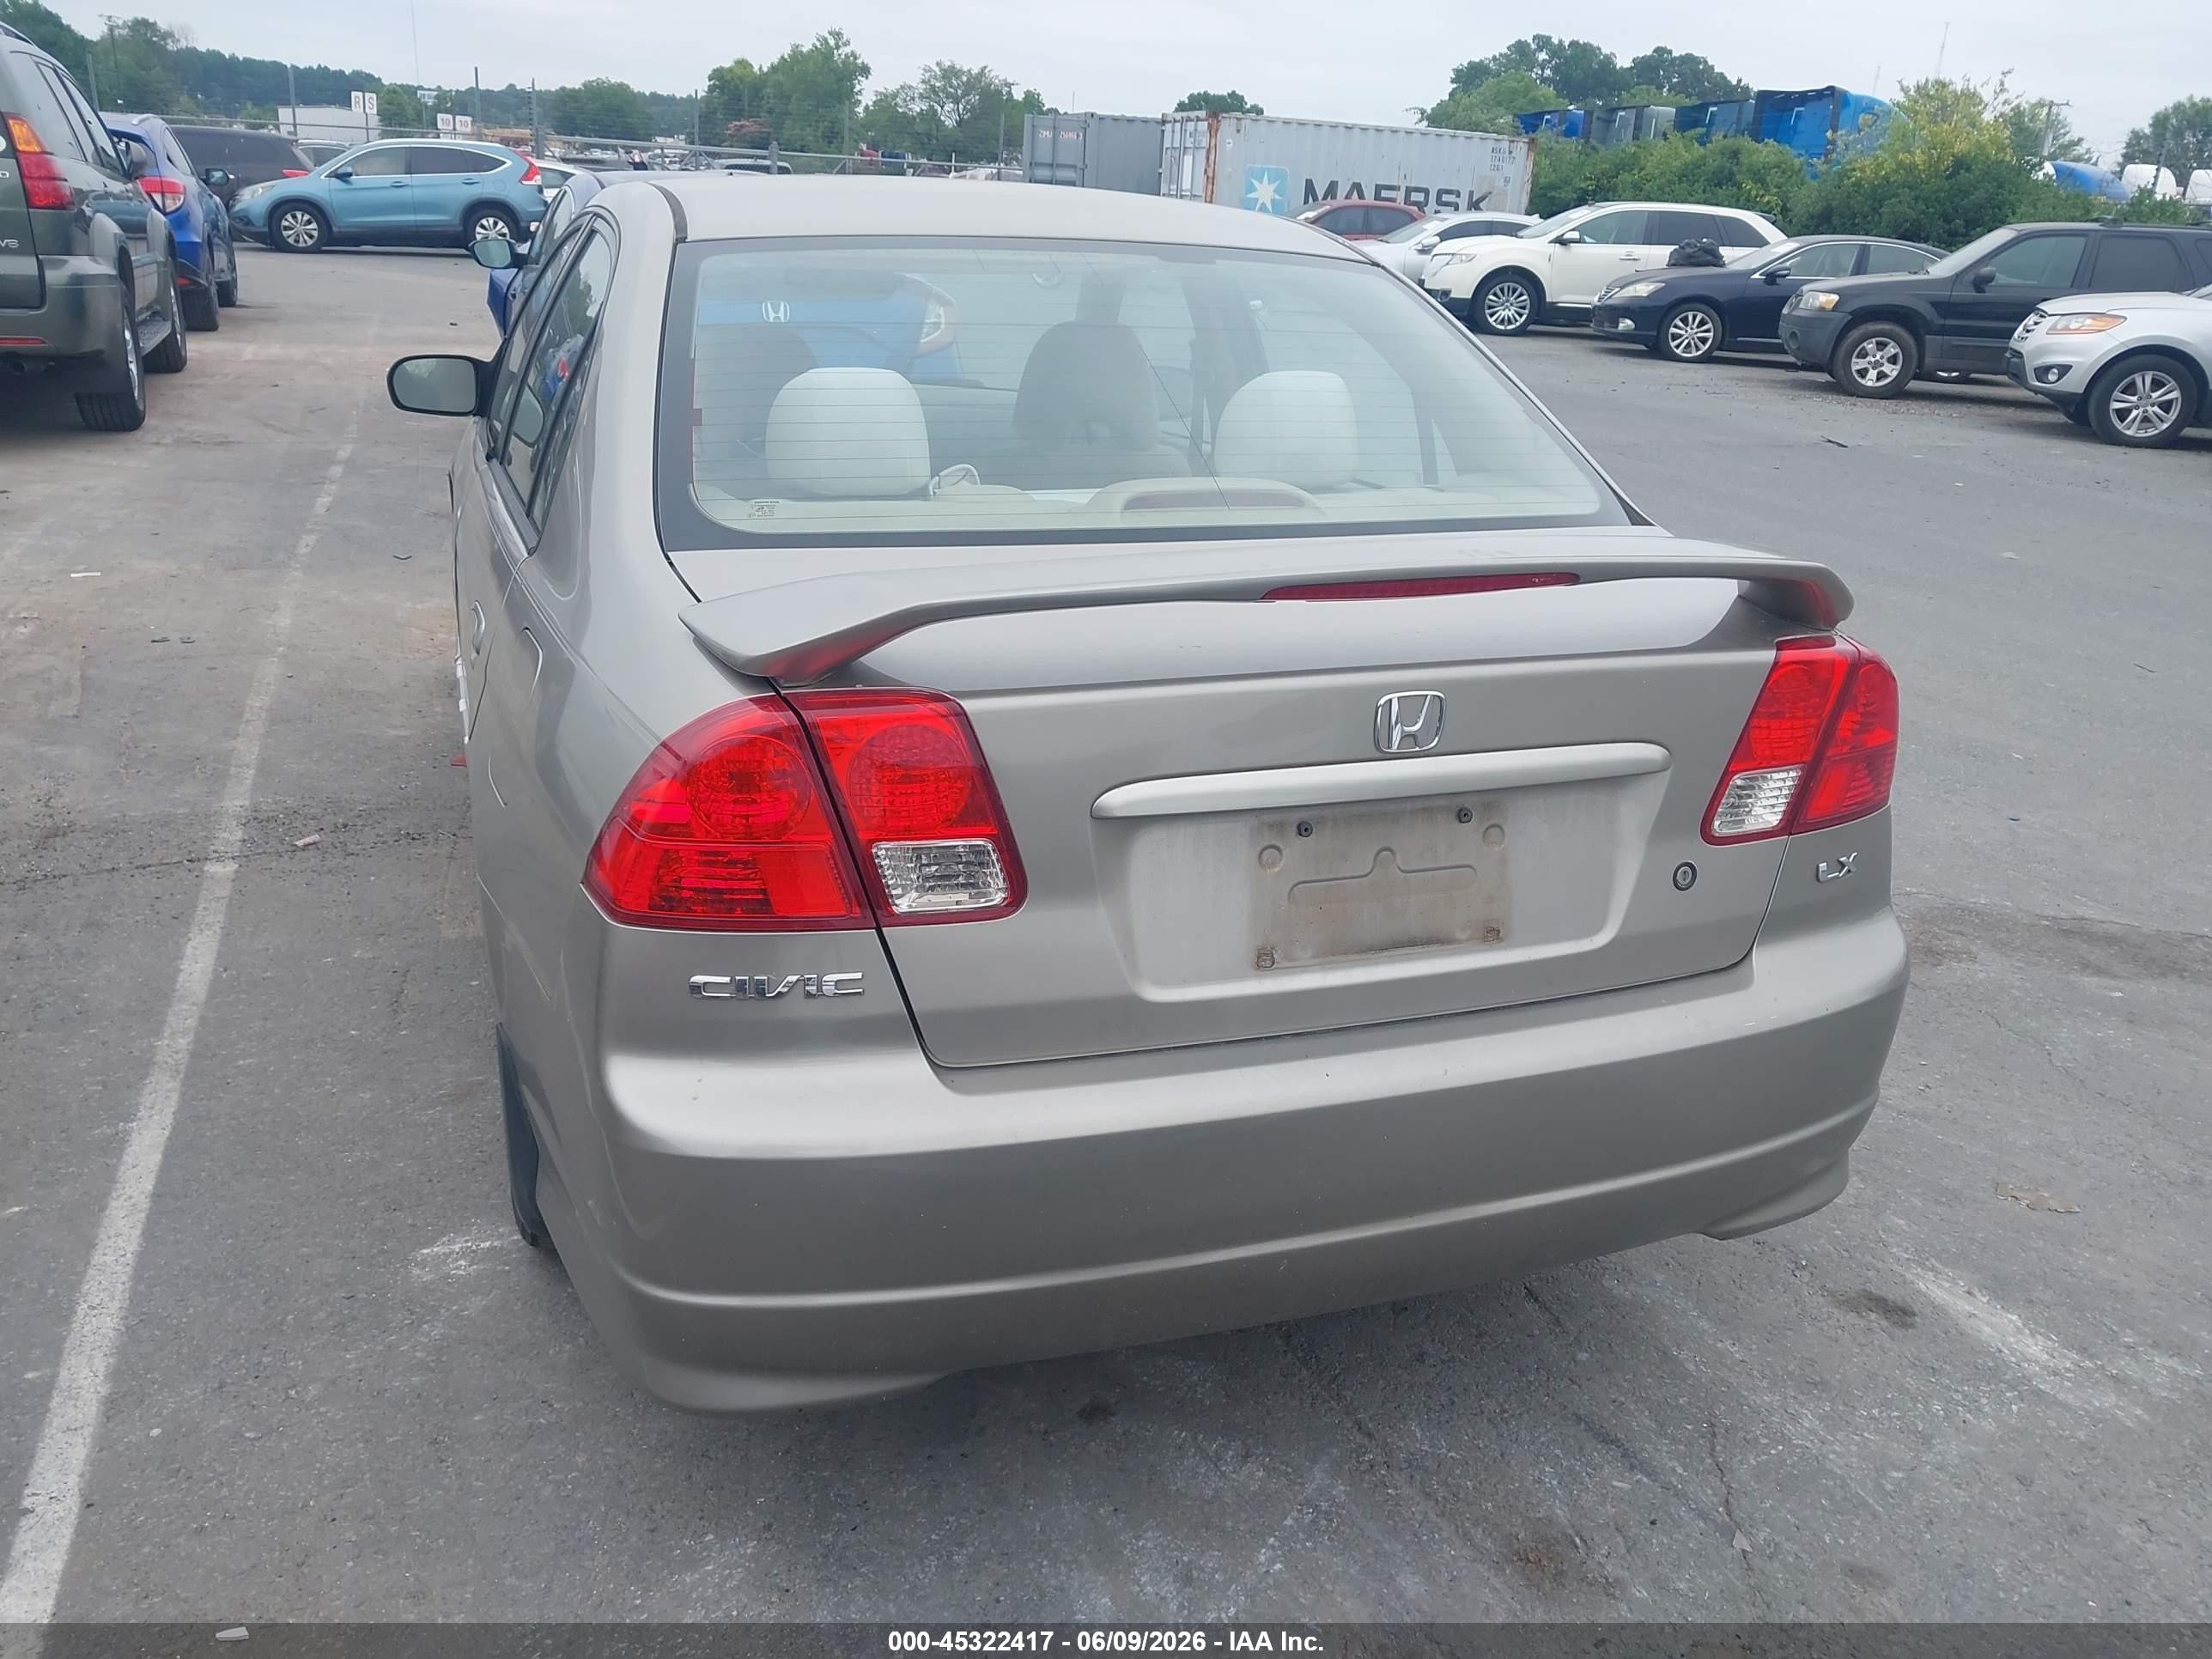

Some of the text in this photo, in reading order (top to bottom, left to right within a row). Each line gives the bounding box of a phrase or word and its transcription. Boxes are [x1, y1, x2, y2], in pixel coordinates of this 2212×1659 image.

[354, 96, 361, 109] R
[368, 97, 374, 110] S
[441, 118, 450, 126] 10
[459, 119, 469, 128] 10
[1304, 178, 1492, 215] MAERSK
[1816, 852, 1857, 883] LX
[689, 972, 864, 1000] CIVIC
